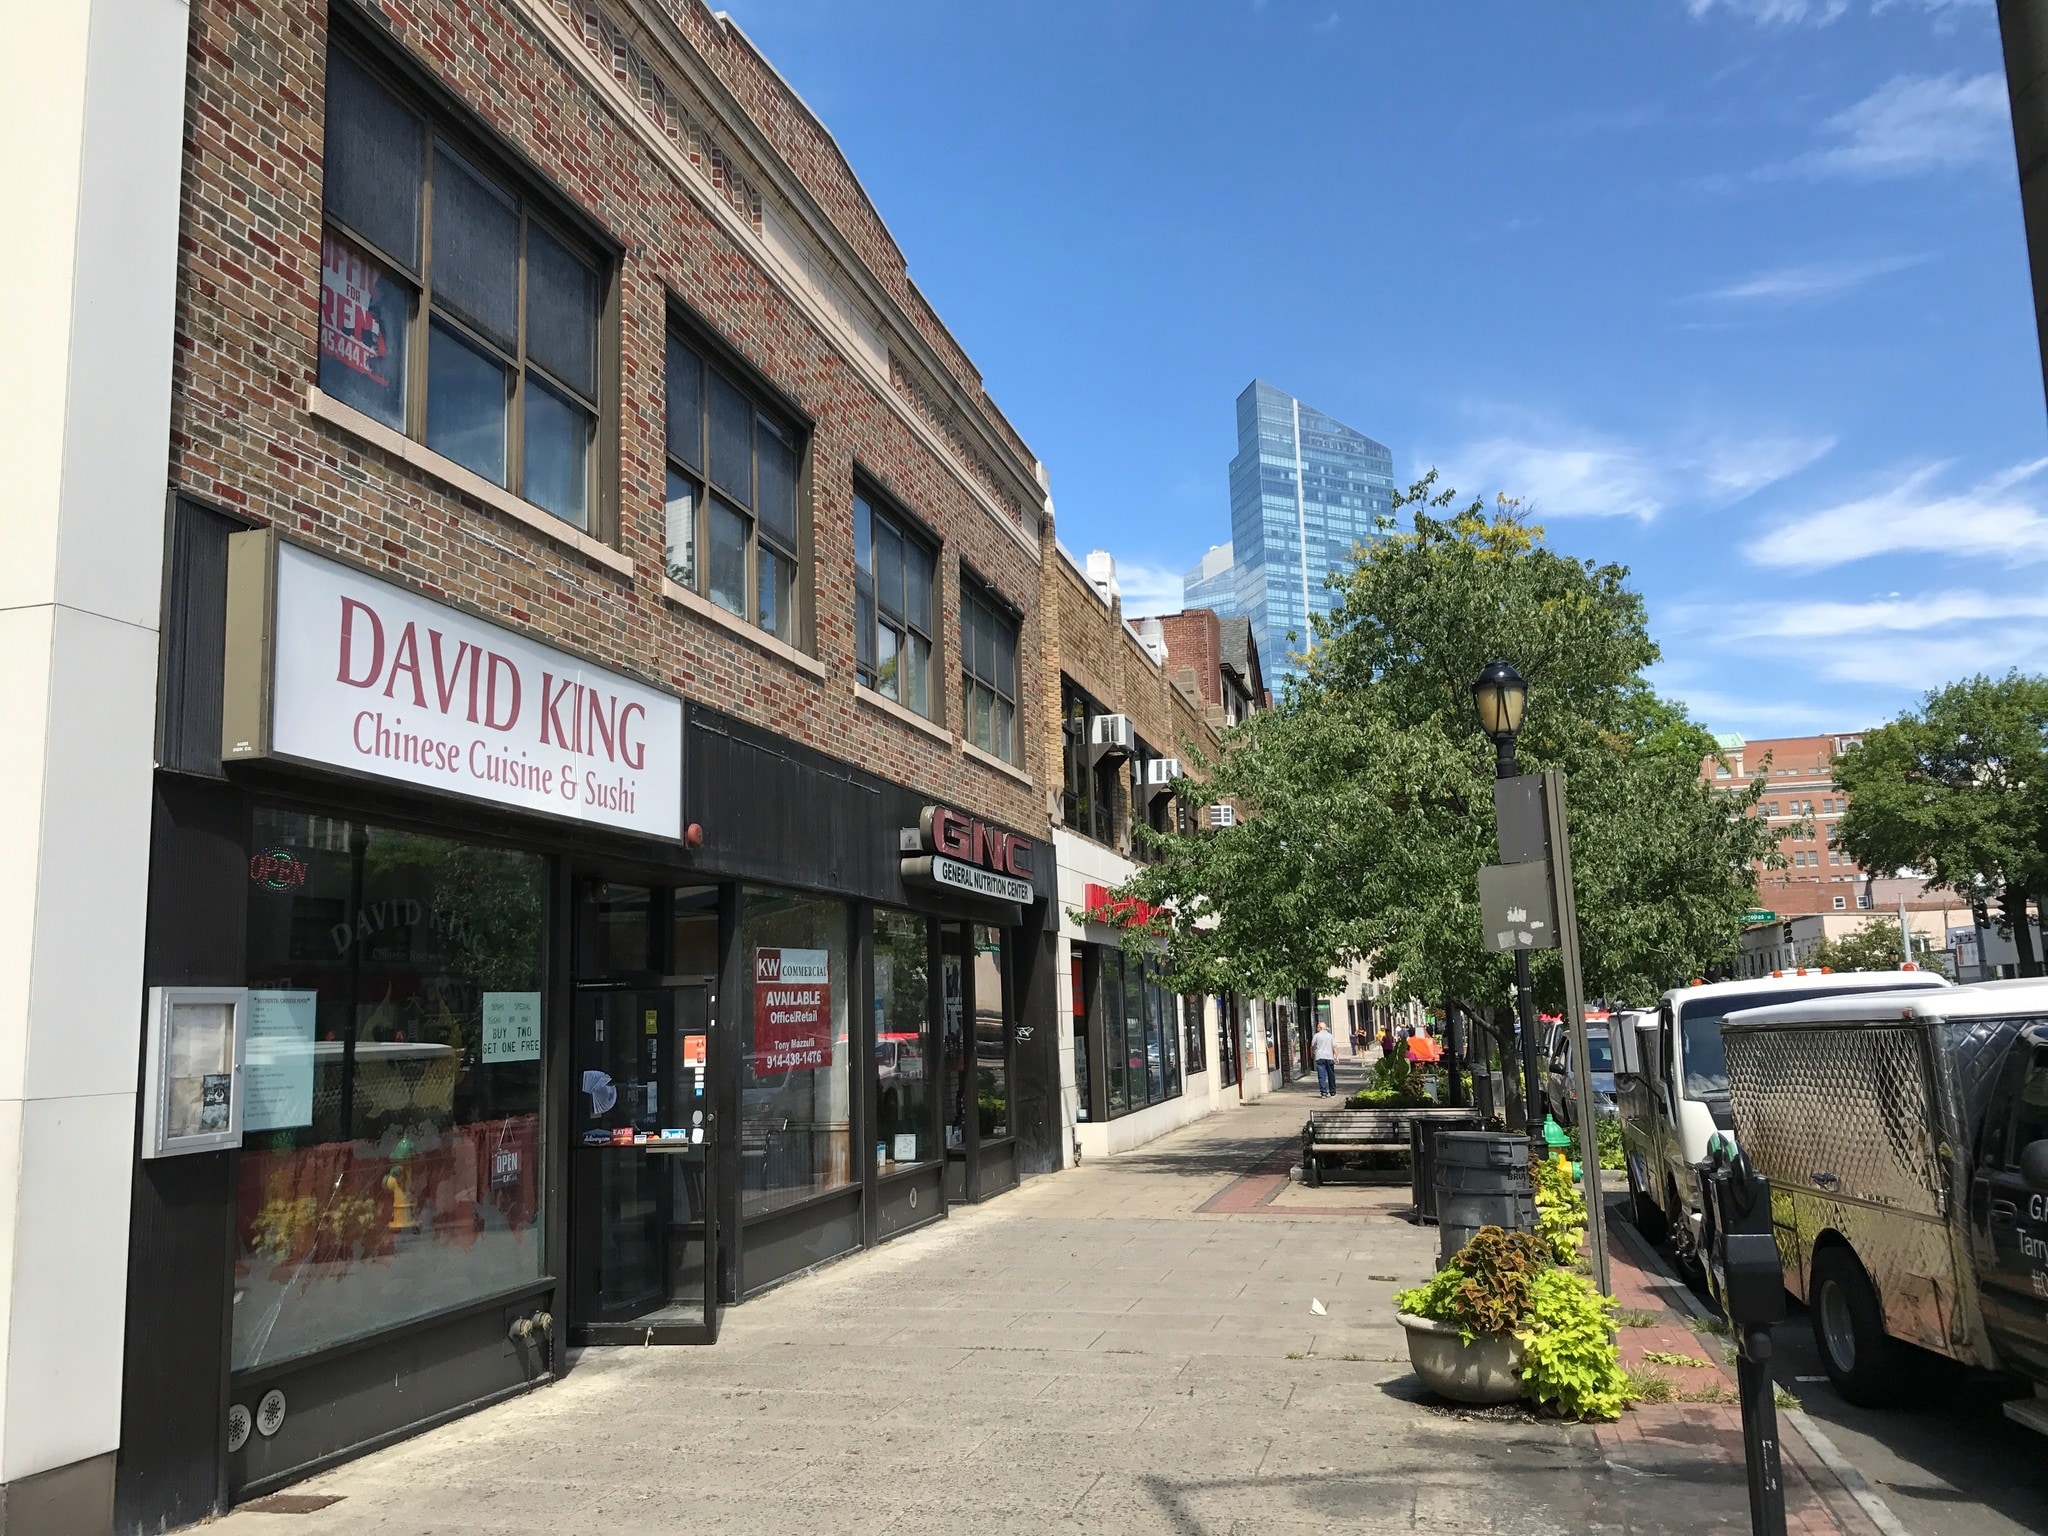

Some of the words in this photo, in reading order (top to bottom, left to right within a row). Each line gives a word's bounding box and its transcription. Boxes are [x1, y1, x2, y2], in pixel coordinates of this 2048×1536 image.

[346, 284, 361, 303] FOR
[336, 595, 522, 732] DAVID
[538, 672, 646, 770] KING
[353, 710, 460, 773] Chinese
[468, 739, 553, 794] Cuisine
[560, 764, 579, 800] &
[585, 770, 636, 814] Sushi
[932, 806, 1034, 880] GNC
[249, 855, 309, 885] OPEN
[942, 861, 973, 887] GENERAL
[974, 871, 1007, 896] NUTRITION
[1007, 880, 1029, 900] CENTER
[329, 898, 423, 956] DAVID
[372, 947, 407, 961] Chinese
[758, 958, 780, 977] KW
[782, 965, 827, 977] COMMERCIAL
[766, 990, 821, 1006] AVAILABLE
[770, 1010, 818, 1025] Office/Retail
[492, 1028, 507, 1039] BUY
[517, 1027, 532, 1038] TWO
[483, 1042, 497, 1054] GET
[502, 1041, 516, 1053] ONE
[521, 1040, 539, 1052] FREE
[774, 1040, 790, 1051] Tony
[790, 1037, 815, 1049] Mazzulli
[766, 1050, 822, 1068] 914-438-1476
[496, 1152, 518, 1173] OPEN
